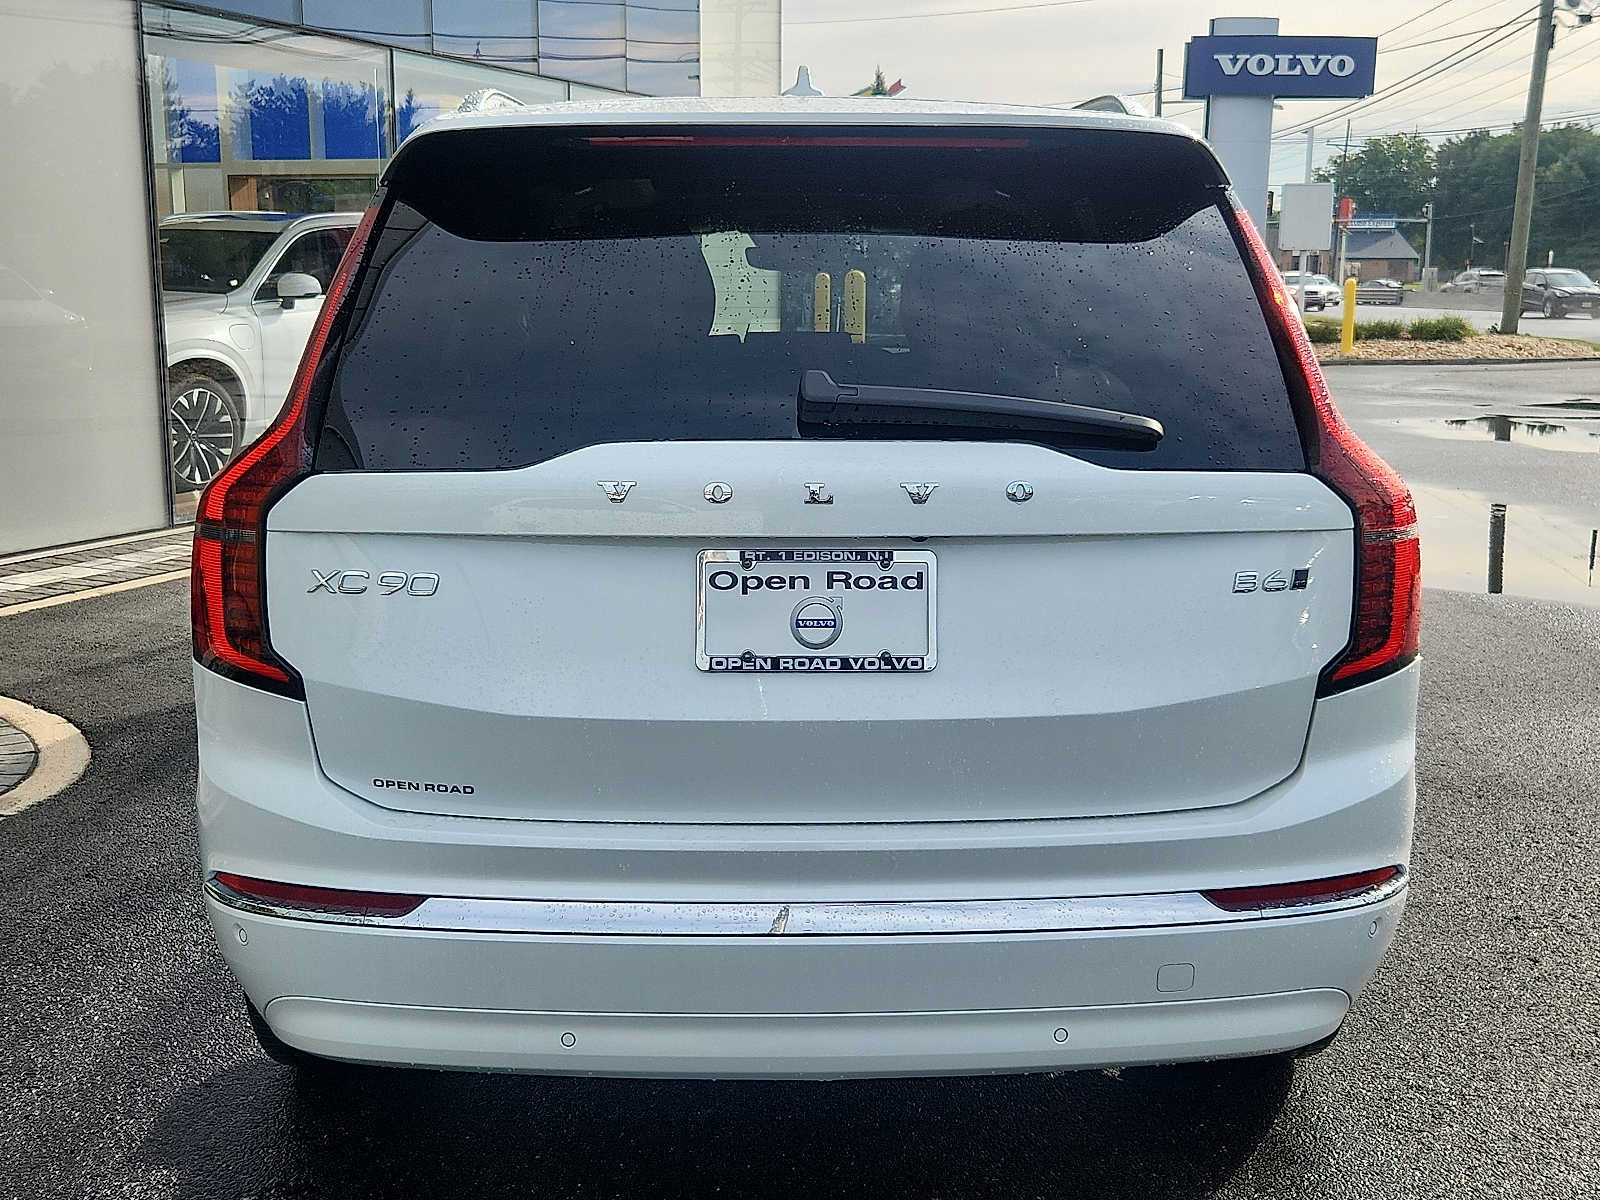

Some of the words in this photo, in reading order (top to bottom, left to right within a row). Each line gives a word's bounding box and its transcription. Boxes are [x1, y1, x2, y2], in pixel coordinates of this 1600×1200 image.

[1213, 54, 1355, 77] VOLVO
[597, 480, 1035, 505] VOLVO
[744, 551, 771, 561] RT.
[778, 551, 786, 561] 1
[708, 570, 810, 596] Open
[826, 571, 924, 590] Road
[1232, 569, 1289, 593] B6
[711, 657, 772, 670] OPEN
[779, 657, 841, 670] ROAD
[848, 657, 923, 670] VOLVO
[373, 778, 420, 791] OPEN
[424, 783, 475, 795] ROAD
